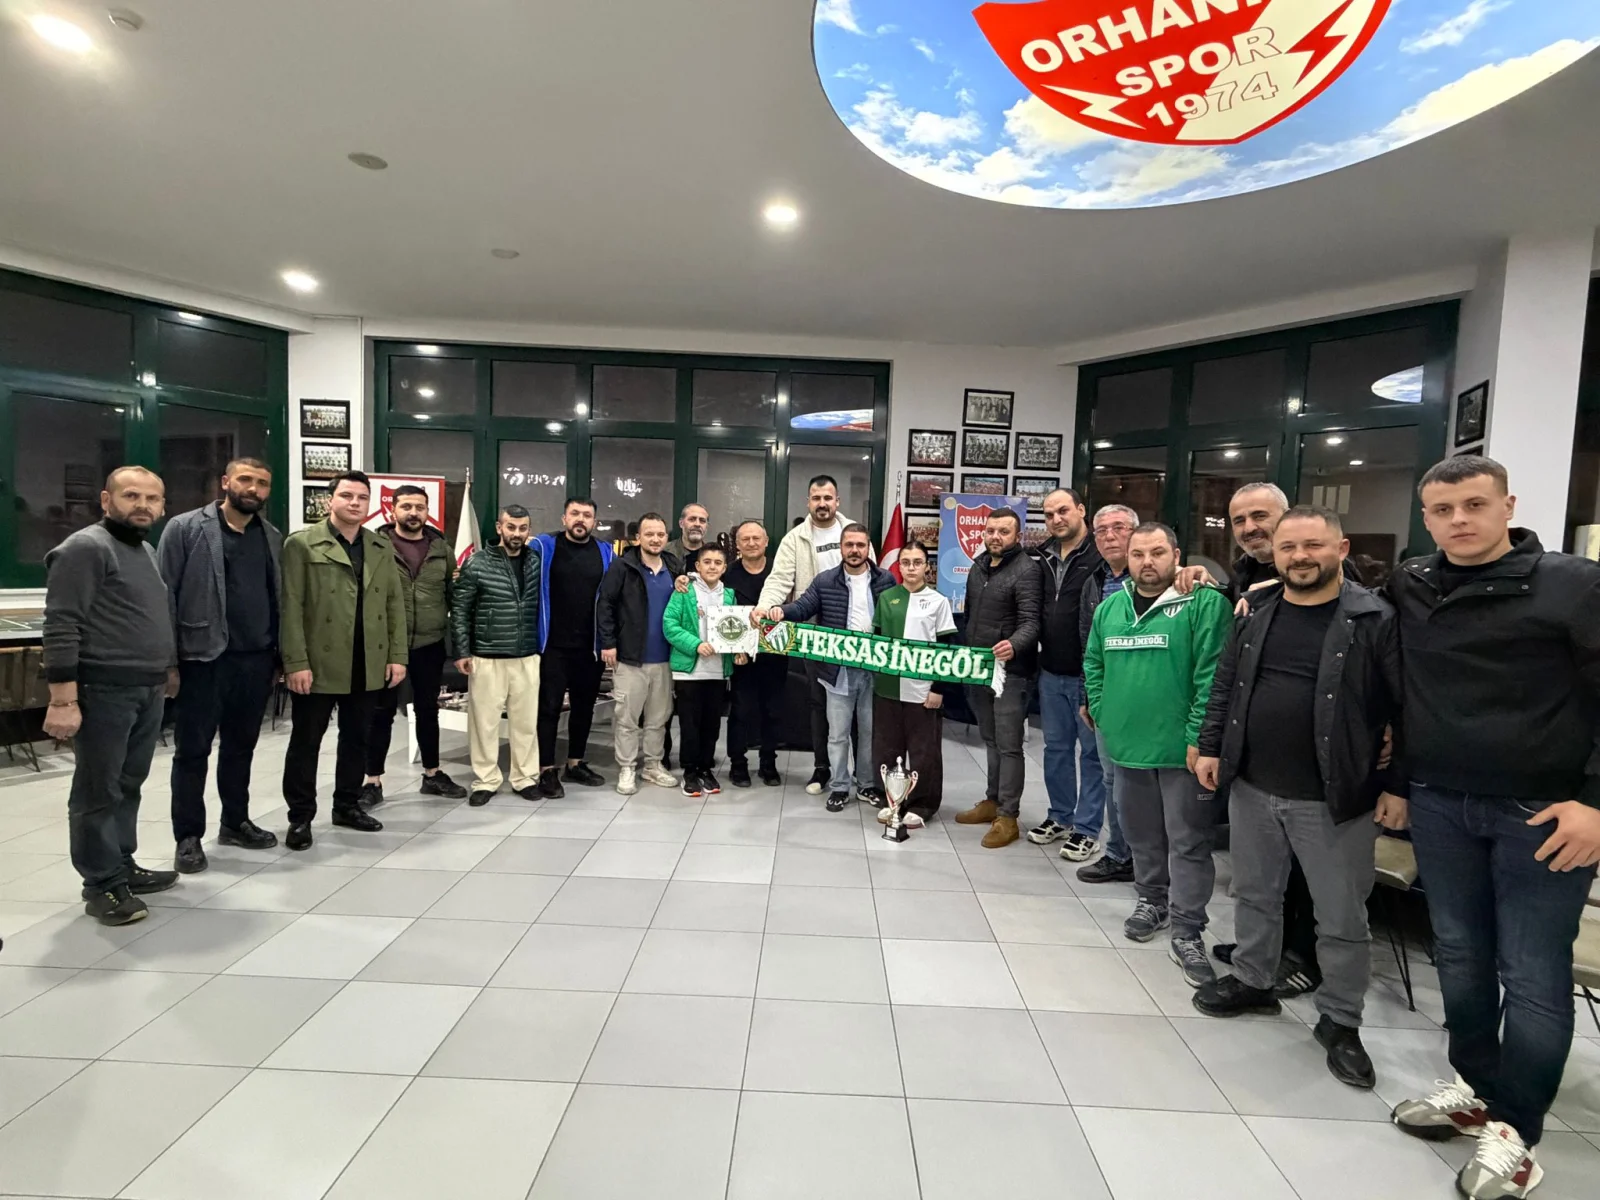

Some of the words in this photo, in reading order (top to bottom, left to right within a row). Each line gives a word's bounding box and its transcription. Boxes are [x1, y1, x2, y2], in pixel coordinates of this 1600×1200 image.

[1020, 0, 1263, 73] ORHAN
[1115, 26, 1282, 97] SPOR
[1146, 71, 1279, 127] 1974
[969, 530, 985, 540] SPO
